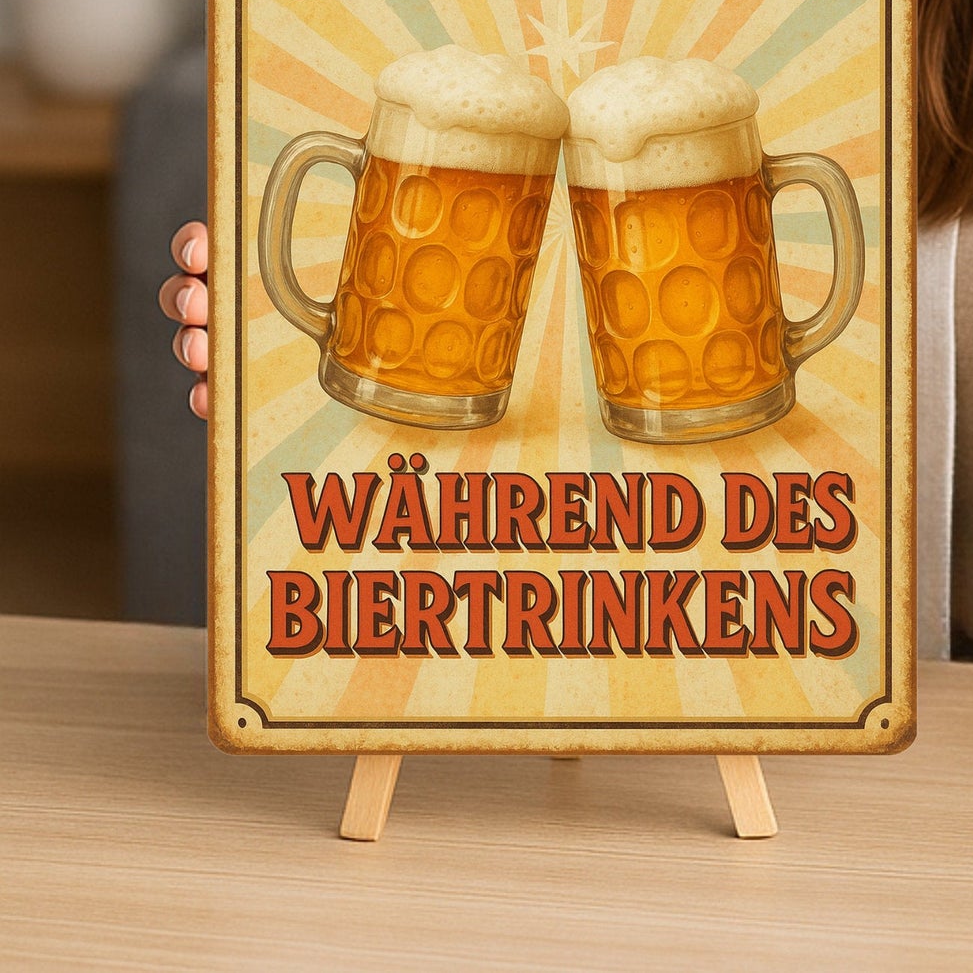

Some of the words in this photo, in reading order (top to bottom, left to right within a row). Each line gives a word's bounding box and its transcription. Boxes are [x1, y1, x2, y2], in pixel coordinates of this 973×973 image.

[281, 452, 703, 552] WÄHREND
[720, 471, 857, 553] DES
[266, 569, 859, 659] BIERTRINKENS
